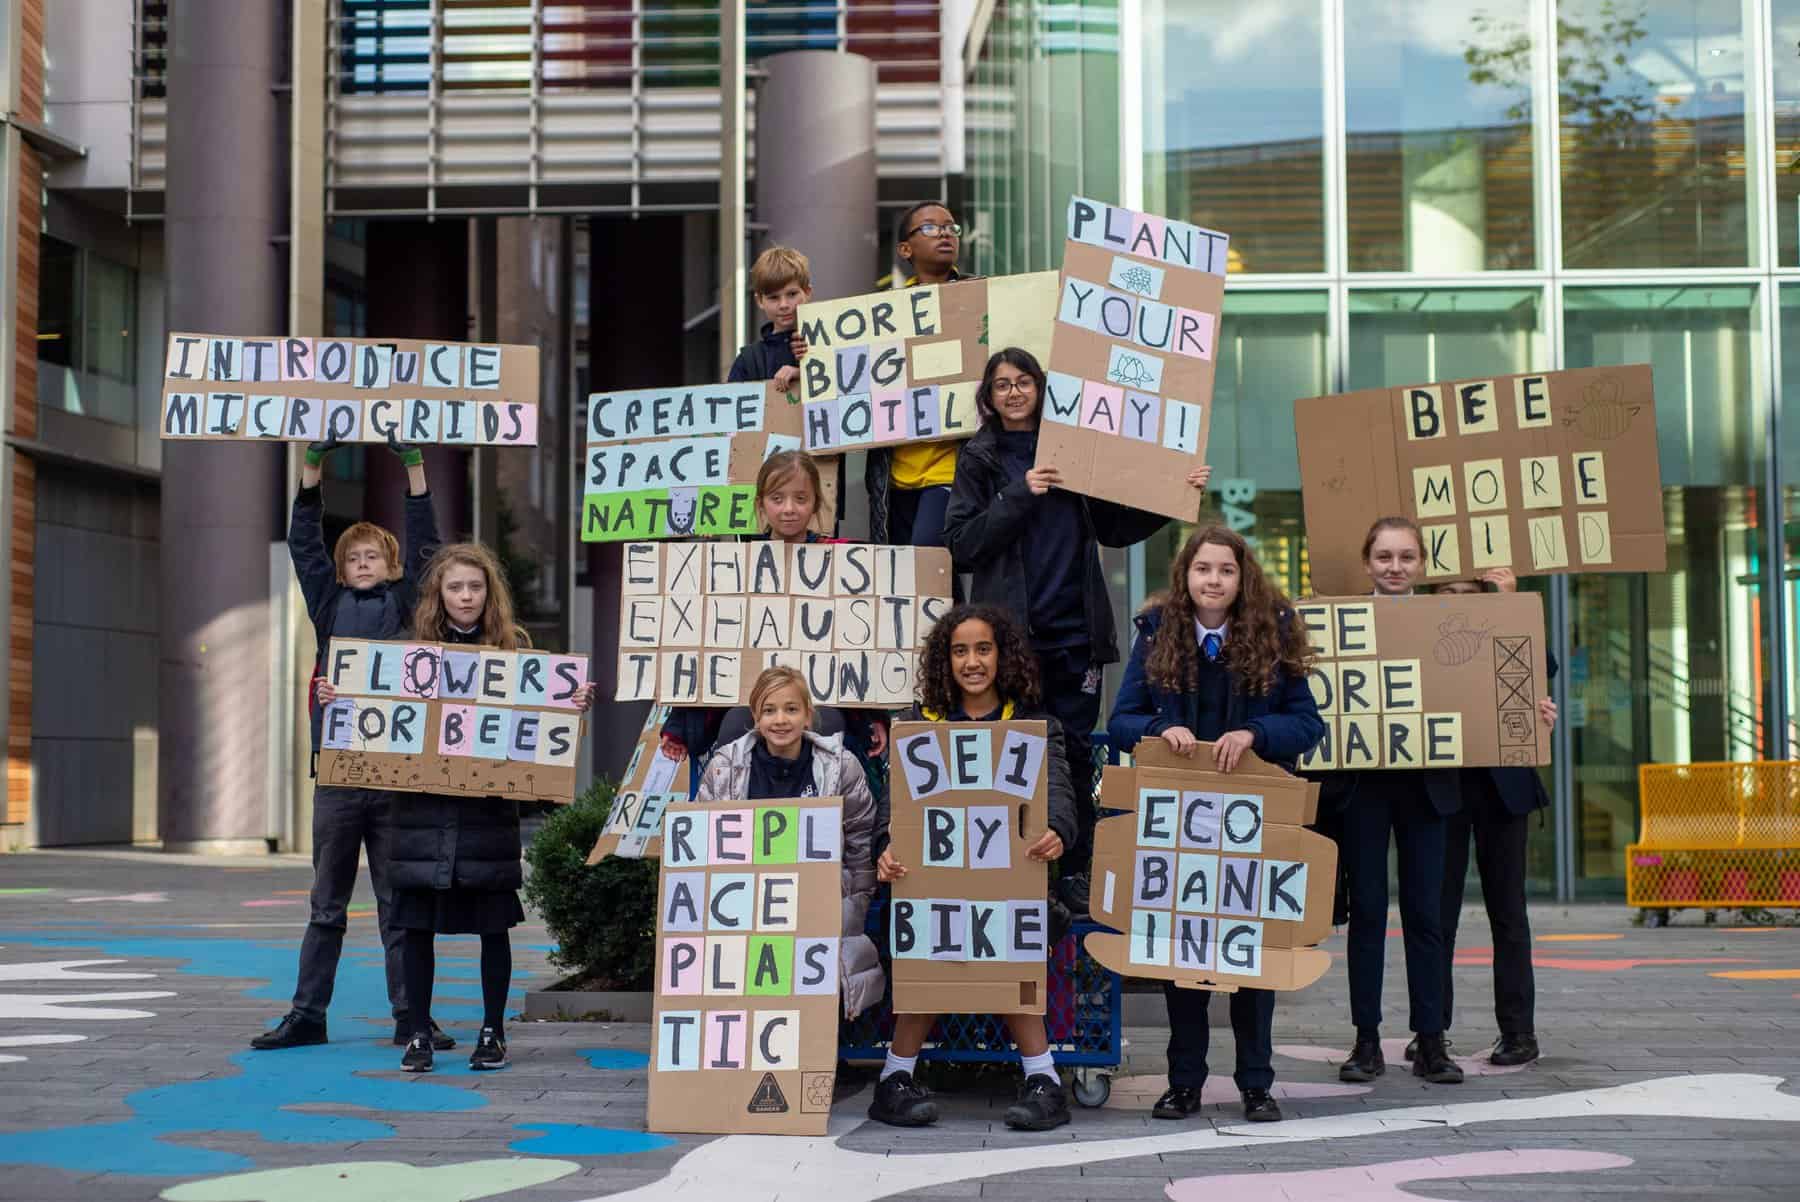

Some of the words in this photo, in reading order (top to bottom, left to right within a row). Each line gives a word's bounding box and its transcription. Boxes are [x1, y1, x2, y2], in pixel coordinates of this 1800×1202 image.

[1073, 201, 1227, 272] PLANT
[801, 291, 934, 346] MORE
[1070, 282, 1204, 353] YOUR
[168, 338, 500, 388] INTRODUCE
[807, 345, 905, 398] BUG
[166, 394, 522, 441] MICROGRIDS
[593, 394, 760, 438] CREATE
[1048, 385, 1187, 449] WAY!
[1411, 377, 1546, 438] BEE
[591, 446, 720, 487] SPACE
[1422, 457, 1598, 506] MORE
[588, 495, 748, 537] NATURE
[629, 544, 904, 594] EXHAUST
[1432, 515, 1605, 571] KIND
[333, 648, 579, 700] FLOWERS
[630, 653, 737, 699] THE
[328, 704, 416, 743] FOR
[445, 712, 571, 756] BEES
[906, 734, 1028, 794] SE1
[671, 810, 832, 862] REPL
[927, 808, 1002, 861] BY
[1143, 796, 1261, 844] ECO
[668, 878, 793, 927] ACE
[1141, 856, 1304, 914] BANK
[895, 901, 1042, 958] BIKE
[1146, 913, 1257, 969] ING
[671, 942, 829, 989] PLAS
[663, 1014, 788, 1068] TIC
